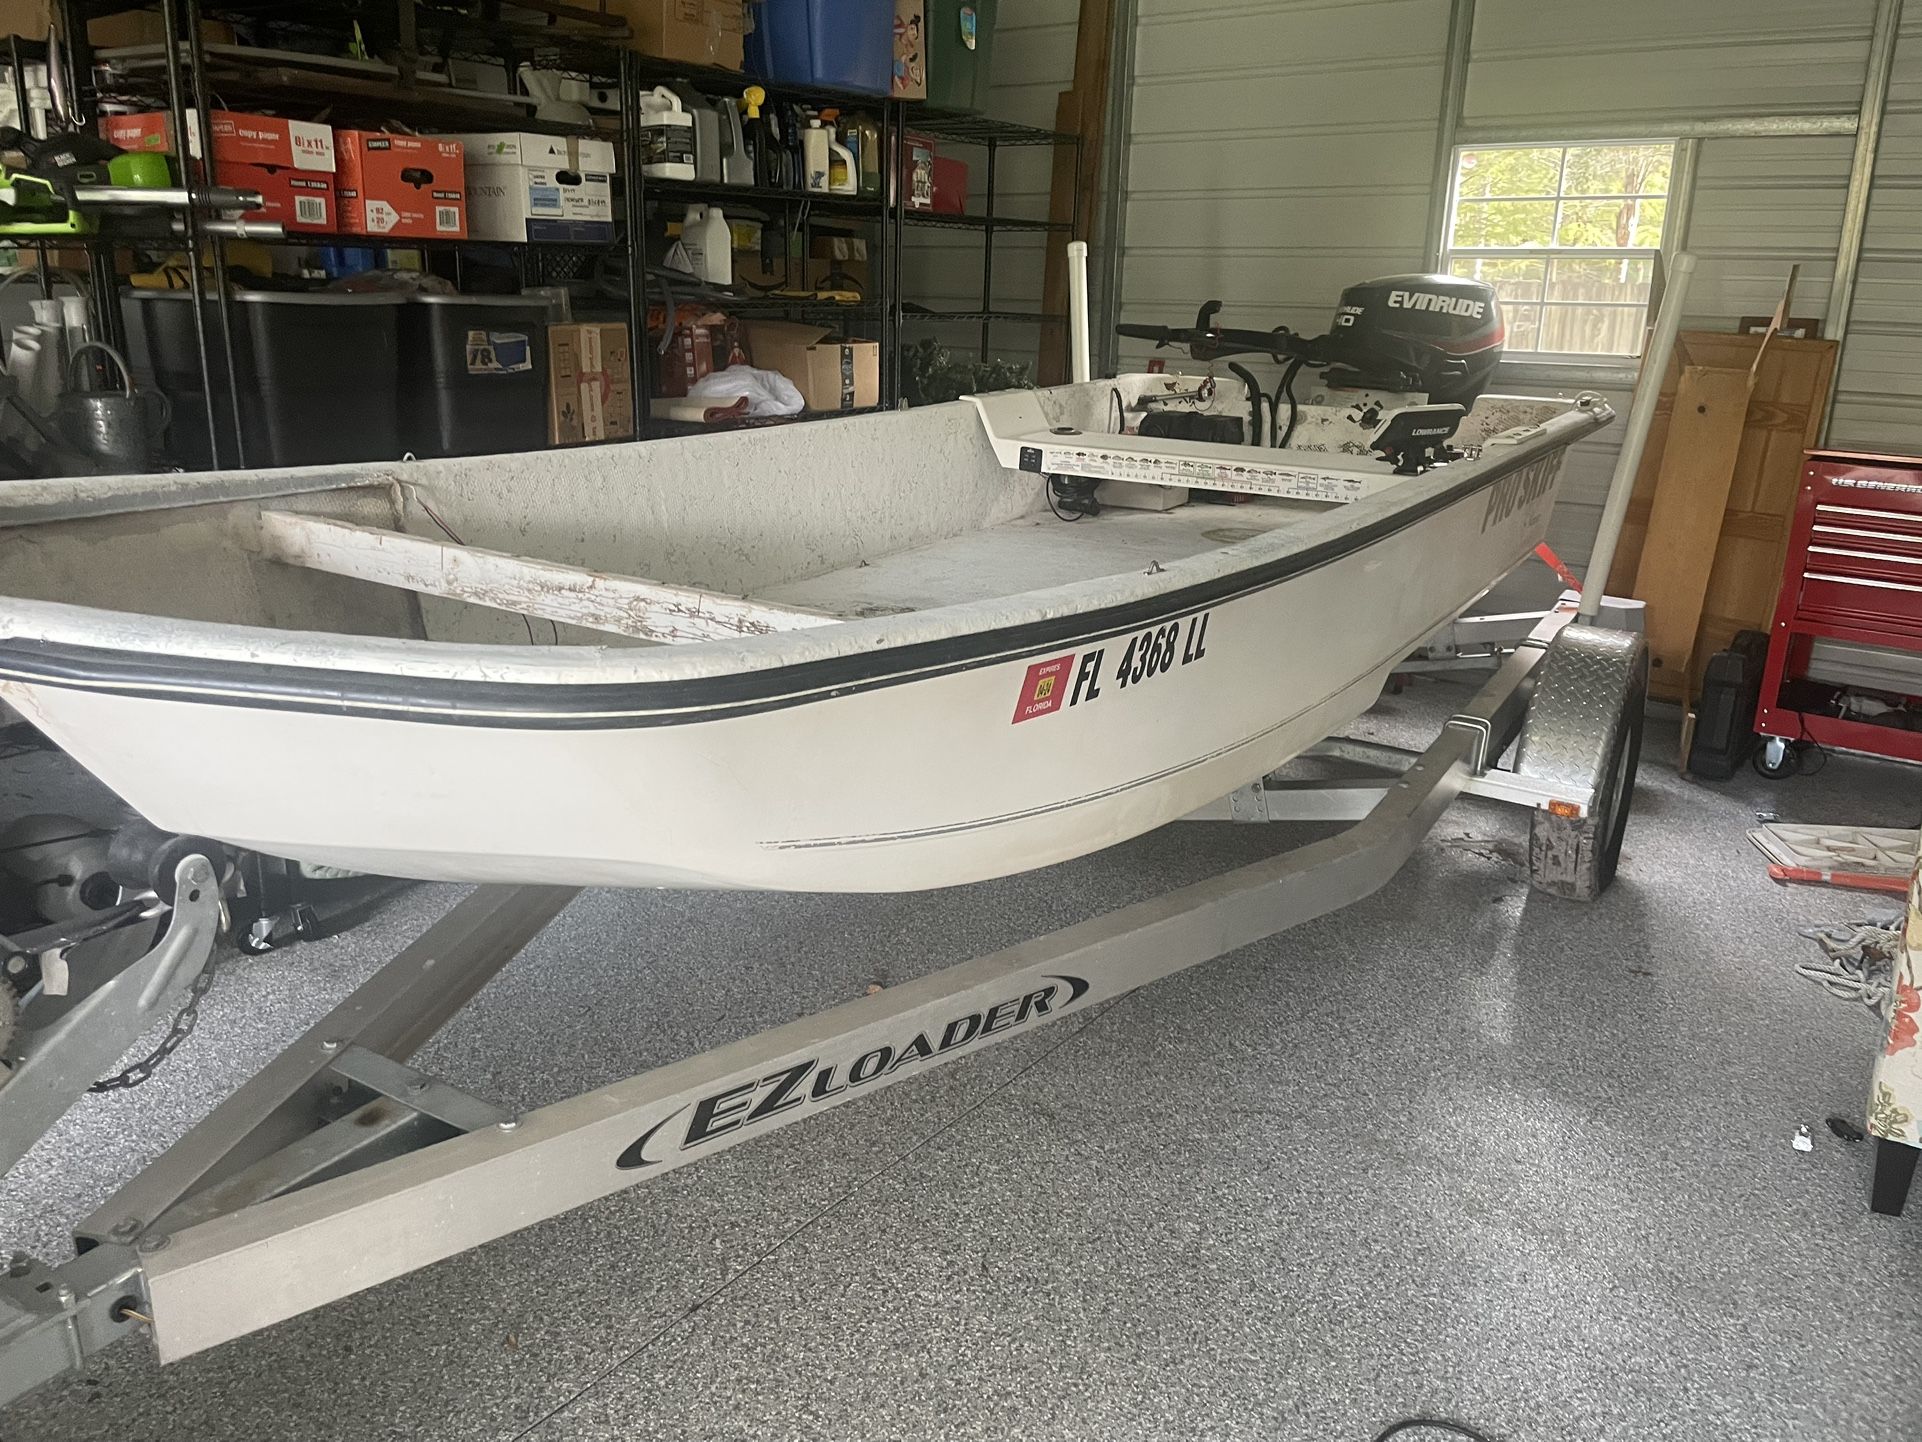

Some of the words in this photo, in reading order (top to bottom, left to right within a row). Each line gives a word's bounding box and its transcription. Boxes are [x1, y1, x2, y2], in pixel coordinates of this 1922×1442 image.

[238, 128, 258, 139] copy
[259, 131, 279, 141] paper
[1388, 290, 1486, 319] EVINRUDE
[1411, 427, 1450, 436] LOWRANCE
[1481, 470, 1523, 535] PRO
[1069, 648, 1105, 707] FL
[1115, 621, 1180, 689] 4368
[1182, 612, 1210, 666] LL
[1038, 663, 1062, 676] EXPIRES
[1025, 700, 1053, 715] FLORIDA
